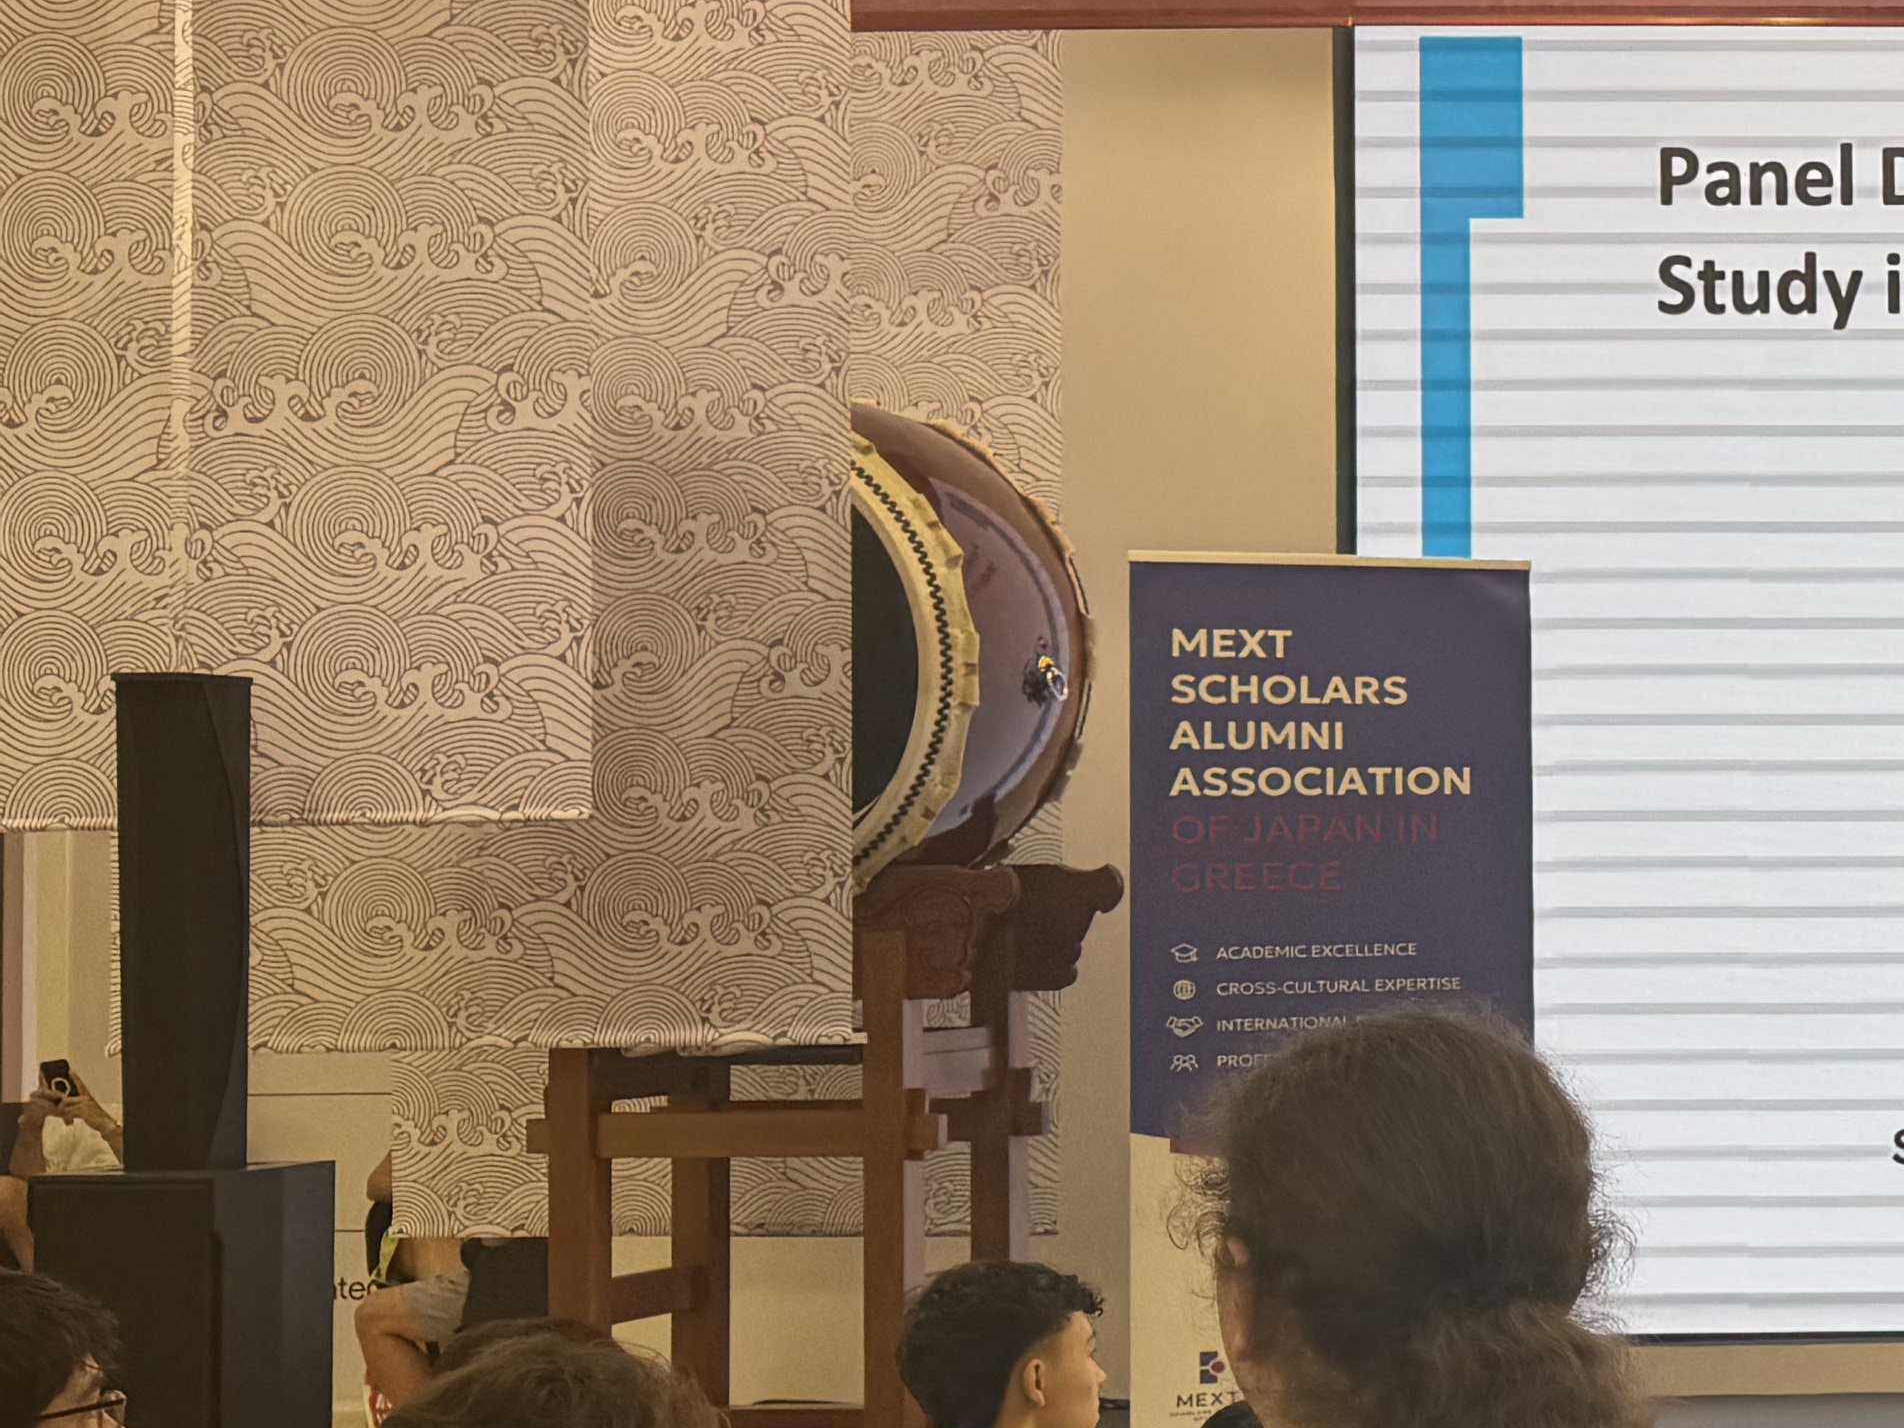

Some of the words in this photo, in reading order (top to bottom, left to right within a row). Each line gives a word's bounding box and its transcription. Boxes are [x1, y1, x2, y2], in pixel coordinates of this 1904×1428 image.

[1655, 143, 1854, 208] Panel
[1656, 252, 1863, 329] Study
[1171, 628, 1293, 658] MEXT
[1171, 675, 1409, 705] SCHOLARS
[1169, 721, 1344, 750] ALUMNI
[1169, 767, 1471, 797] ASSOCIATION
[1172, 816, 1231, 845] OF
[1244, 814, 1384, 845] JAPAN
[1400, 815, 1438, 843] IN
[1172, 861, 1341, 893] GREECE
[1216, 945, 1307, 960] ACADEMIC
[1312, 943, 1418, 958] EXCELLENCE
[1216, 980, 1370, 996] CROSS-CULTURAL
[1375, 977, 1462, 993] EXPERTISE
